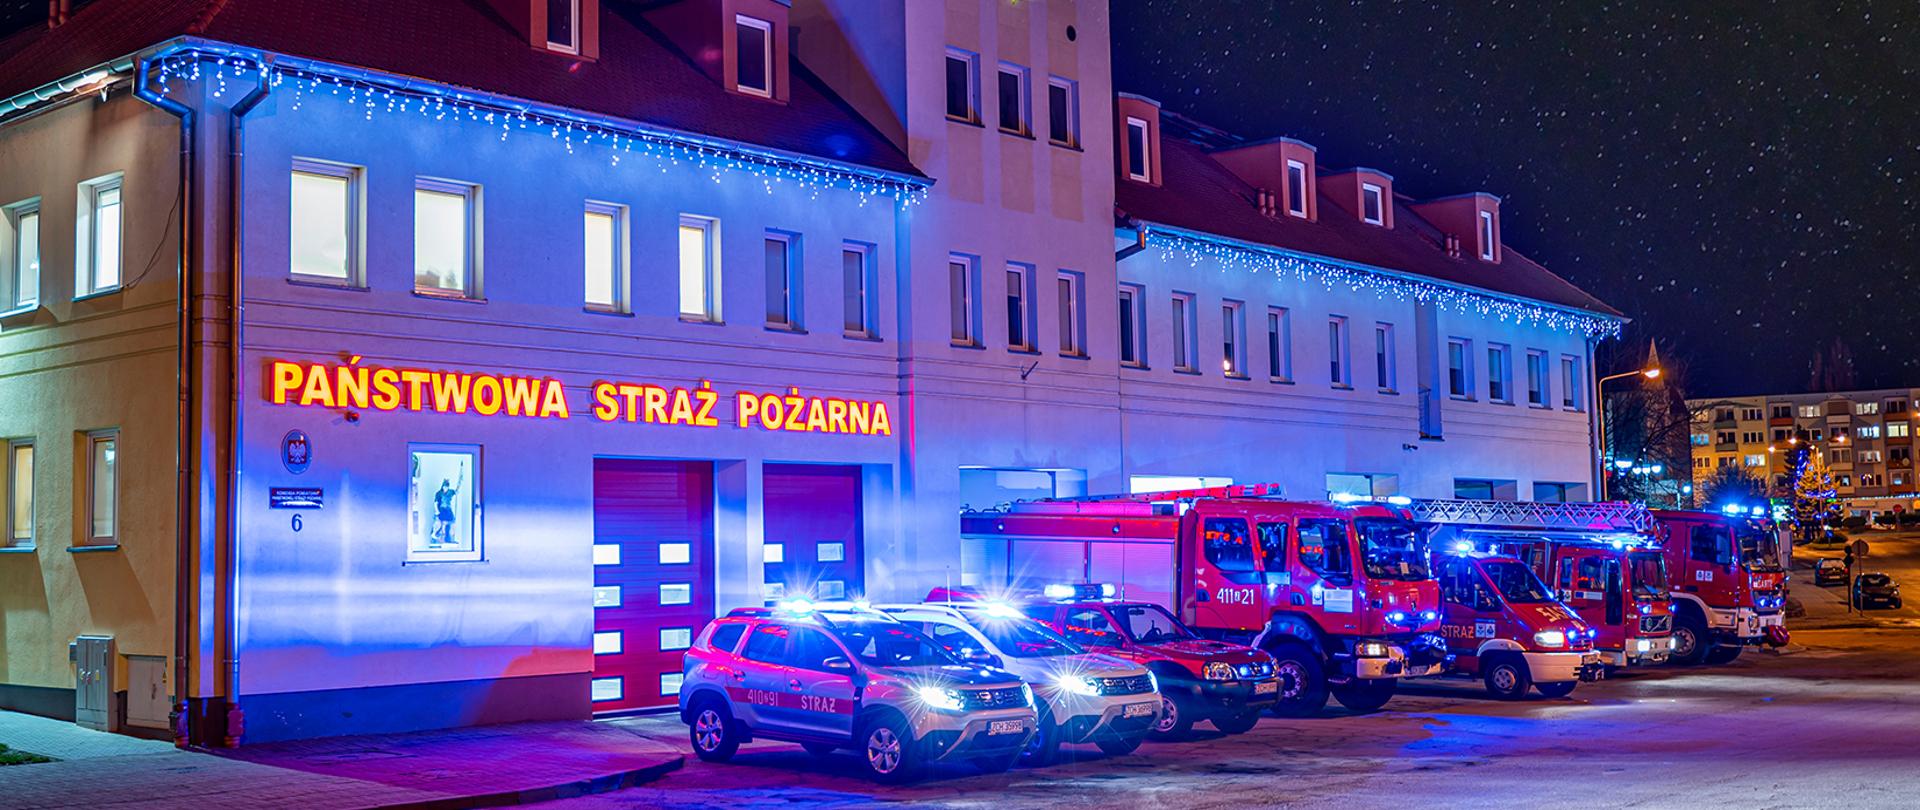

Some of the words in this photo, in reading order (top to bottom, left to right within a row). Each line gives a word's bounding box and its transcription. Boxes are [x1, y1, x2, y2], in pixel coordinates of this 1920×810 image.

[271, 354, 570, 420] PAŃSTWOWA
[595, 380, 719, 428] STRAŻ
[738, 387, 891, 436] POŻARNA
[291, 514, 302, 532] 6
